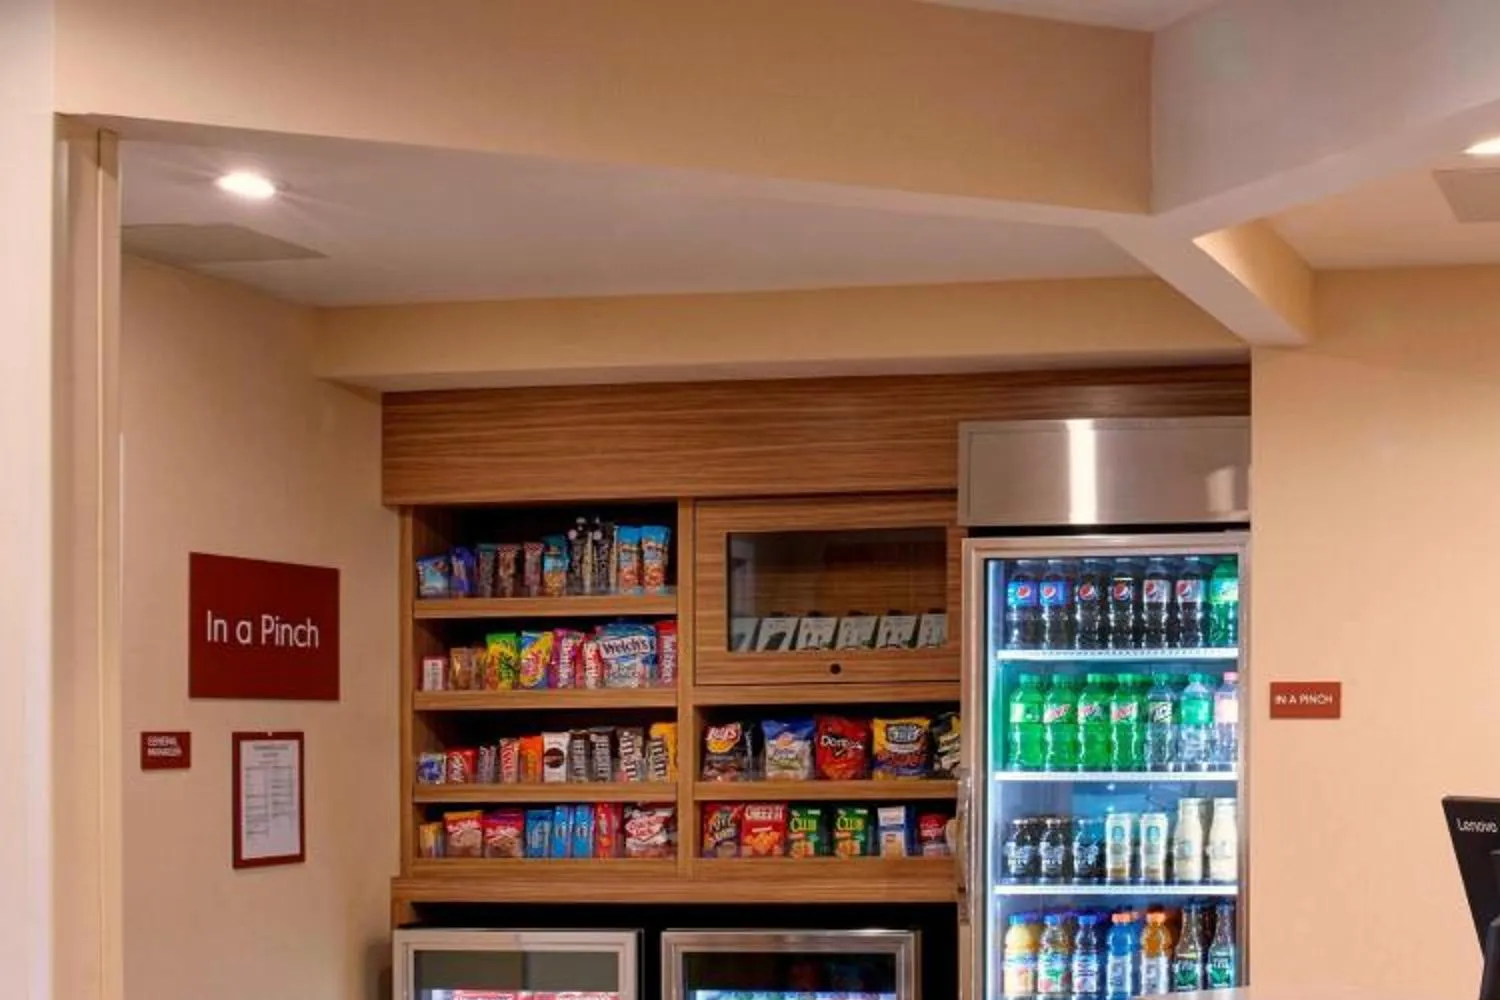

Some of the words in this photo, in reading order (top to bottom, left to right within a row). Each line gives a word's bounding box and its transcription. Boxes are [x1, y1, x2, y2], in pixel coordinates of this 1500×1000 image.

[206, 609, 228, 643] In
[235, 621, 253, 645] a
[261, 614, 320, 649] Pinch
[1456, 817, 1499, 833] Lenovo
